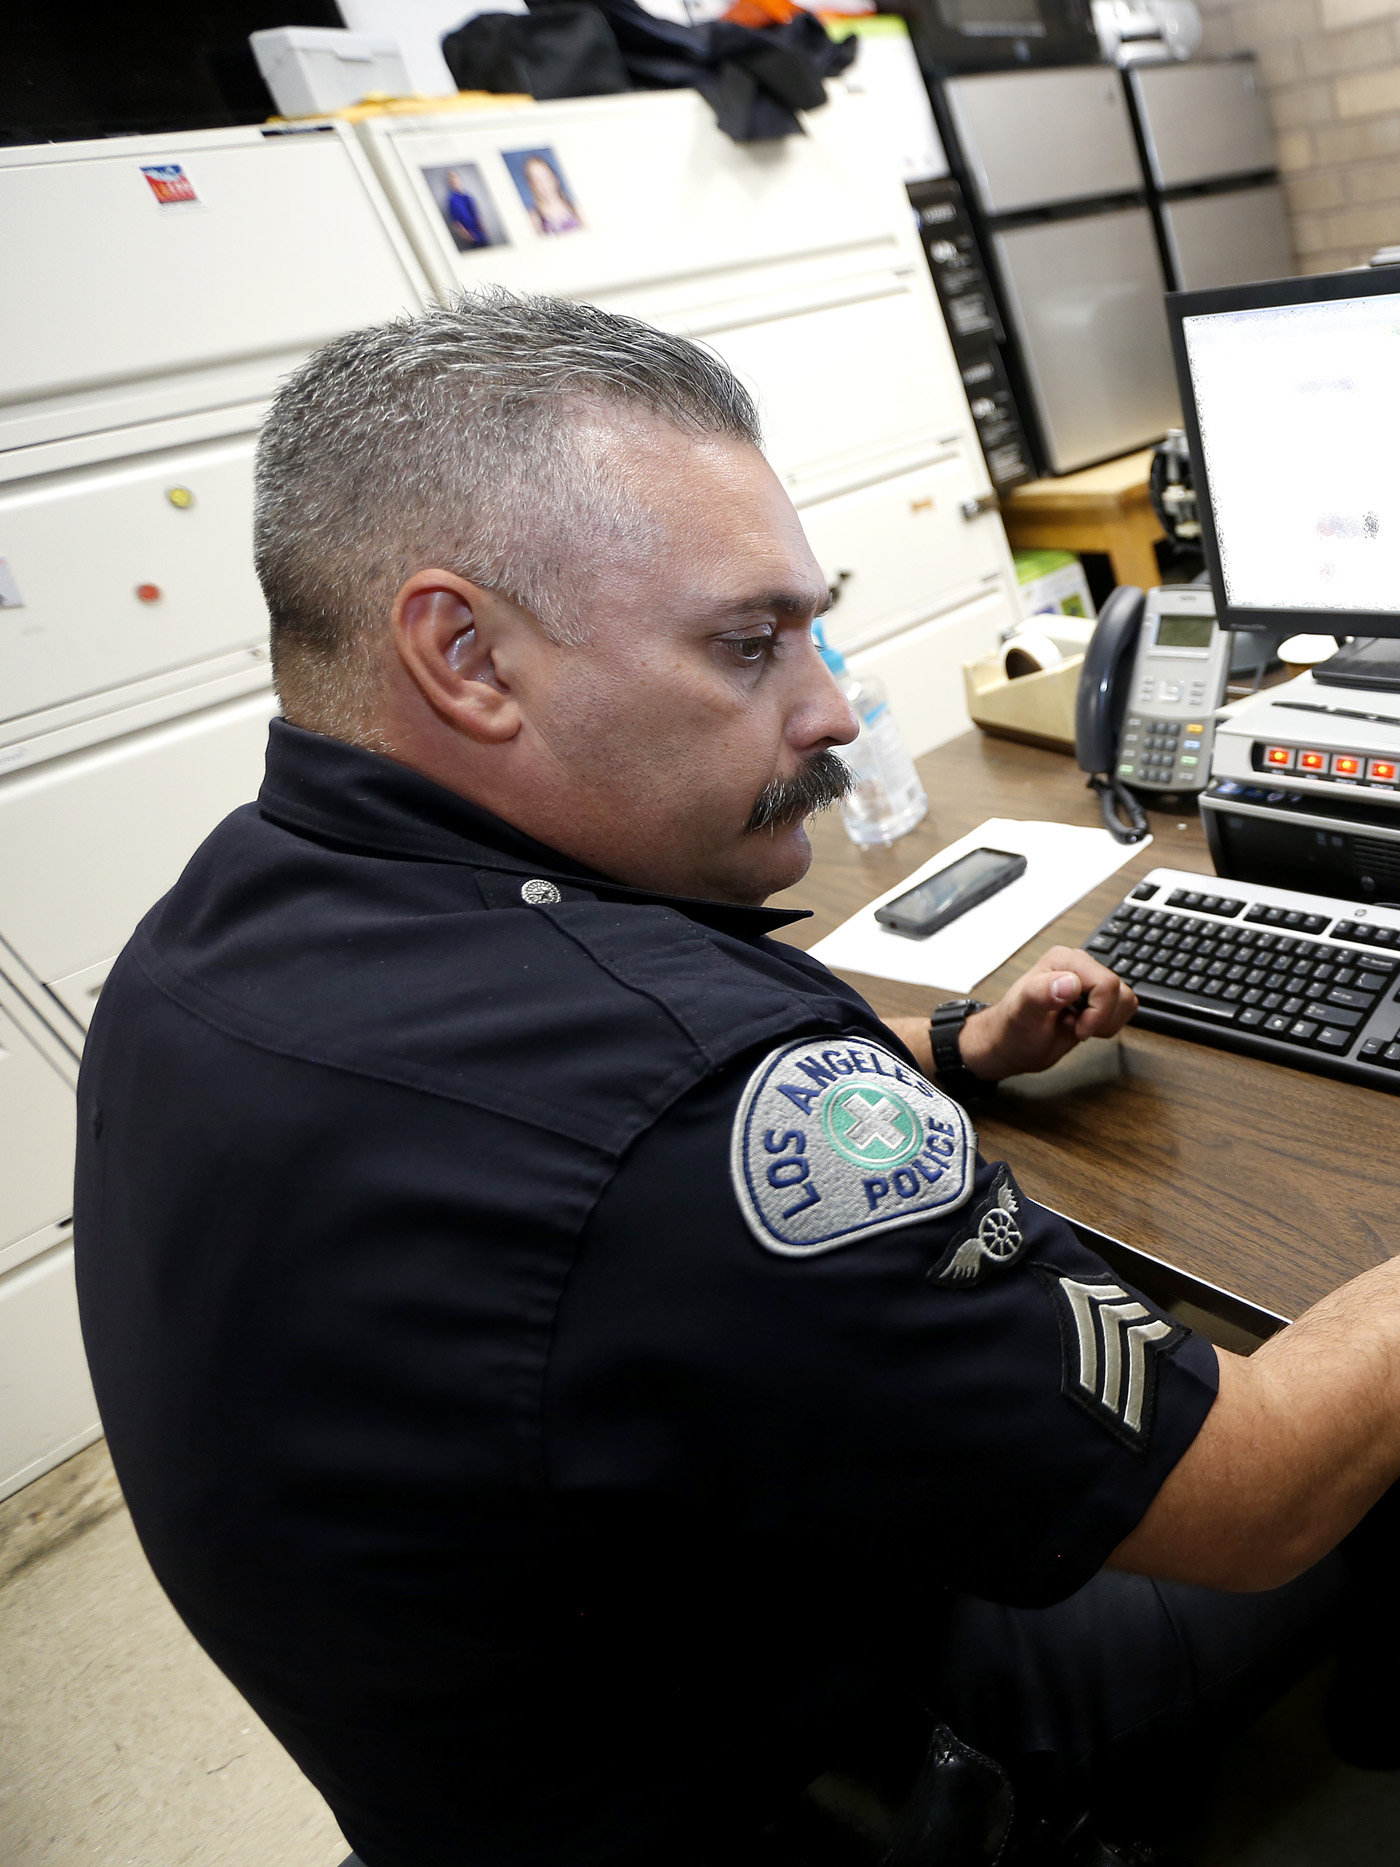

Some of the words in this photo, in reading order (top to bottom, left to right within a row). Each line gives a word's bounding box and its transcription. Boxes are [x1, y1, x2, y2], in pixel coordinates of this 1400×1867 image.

[776, 1049, 938, 1115] ANGELES
[762, 1129, 819, 1221] LOS
[862, 1117, 956, 1211] POLICE
